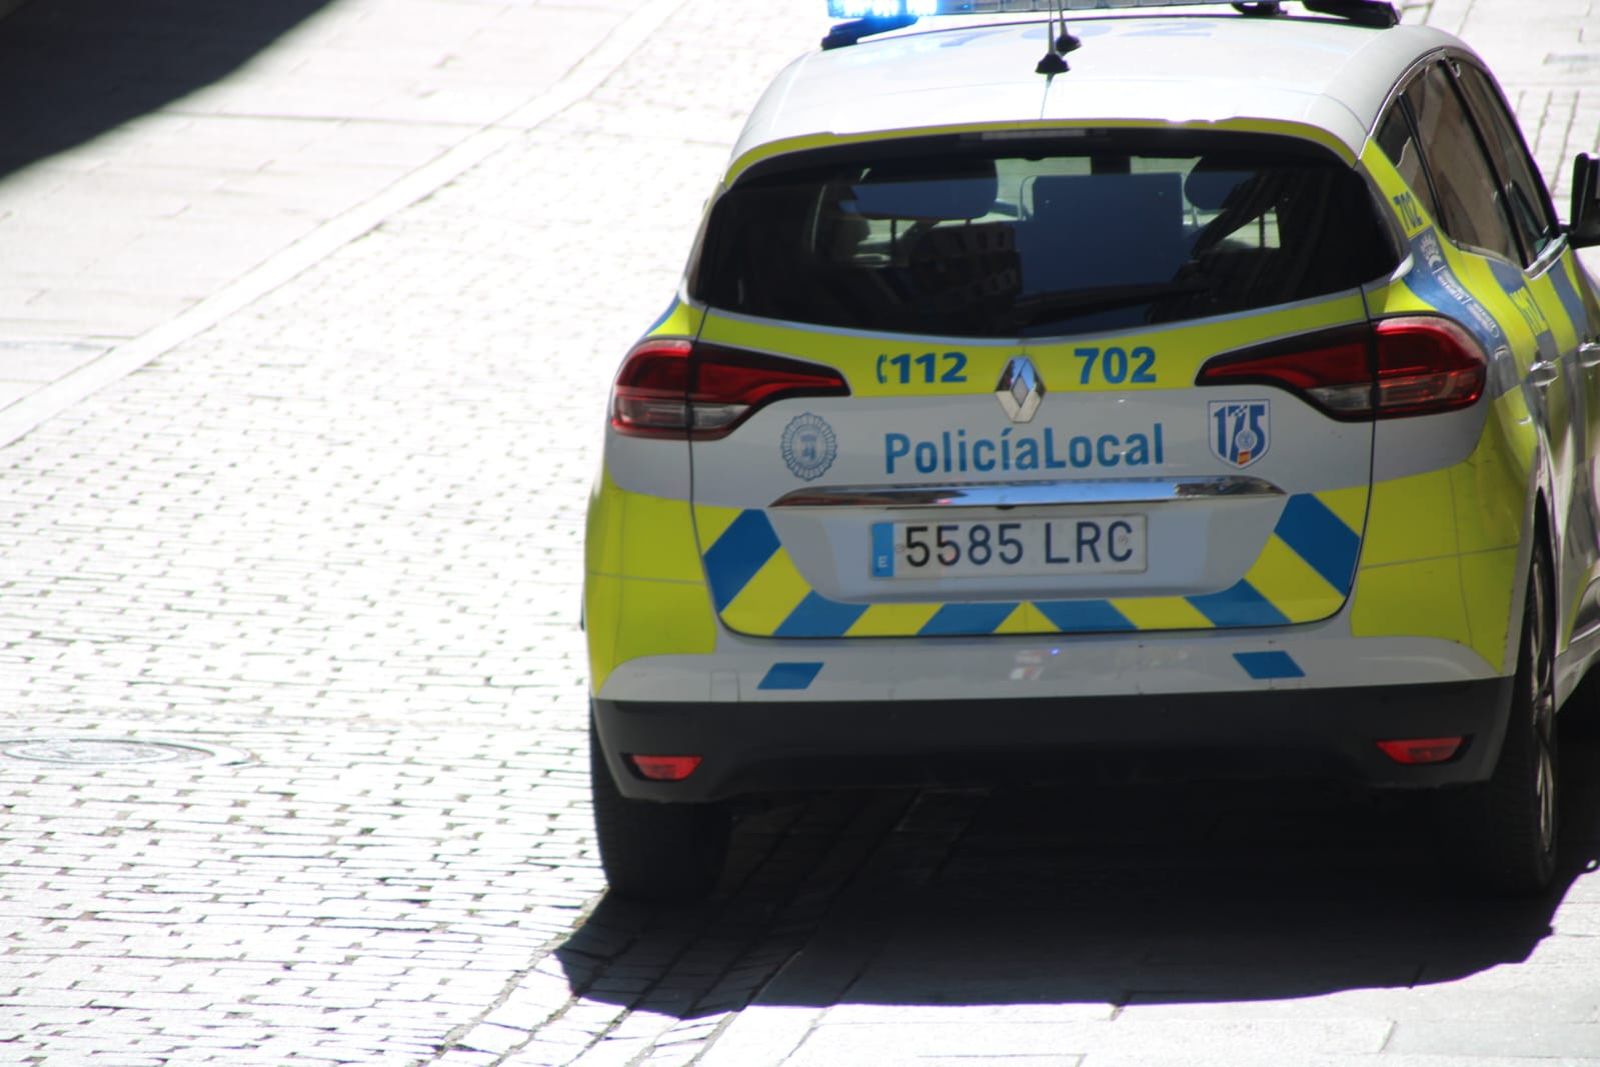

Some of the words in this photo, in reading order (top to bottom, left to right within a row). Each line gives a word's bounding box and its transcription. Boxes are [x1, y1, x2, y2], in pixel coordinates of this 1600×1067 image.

[890, 352, 968, 384] 112
[1074, 347, 1157, 384] 702
[1213, 404, 1265, 463] 175
[877, 554, 889, 569] E
[906, 524, 1023, 567] 5585
[1045, 521, 1132, 564] LRC
